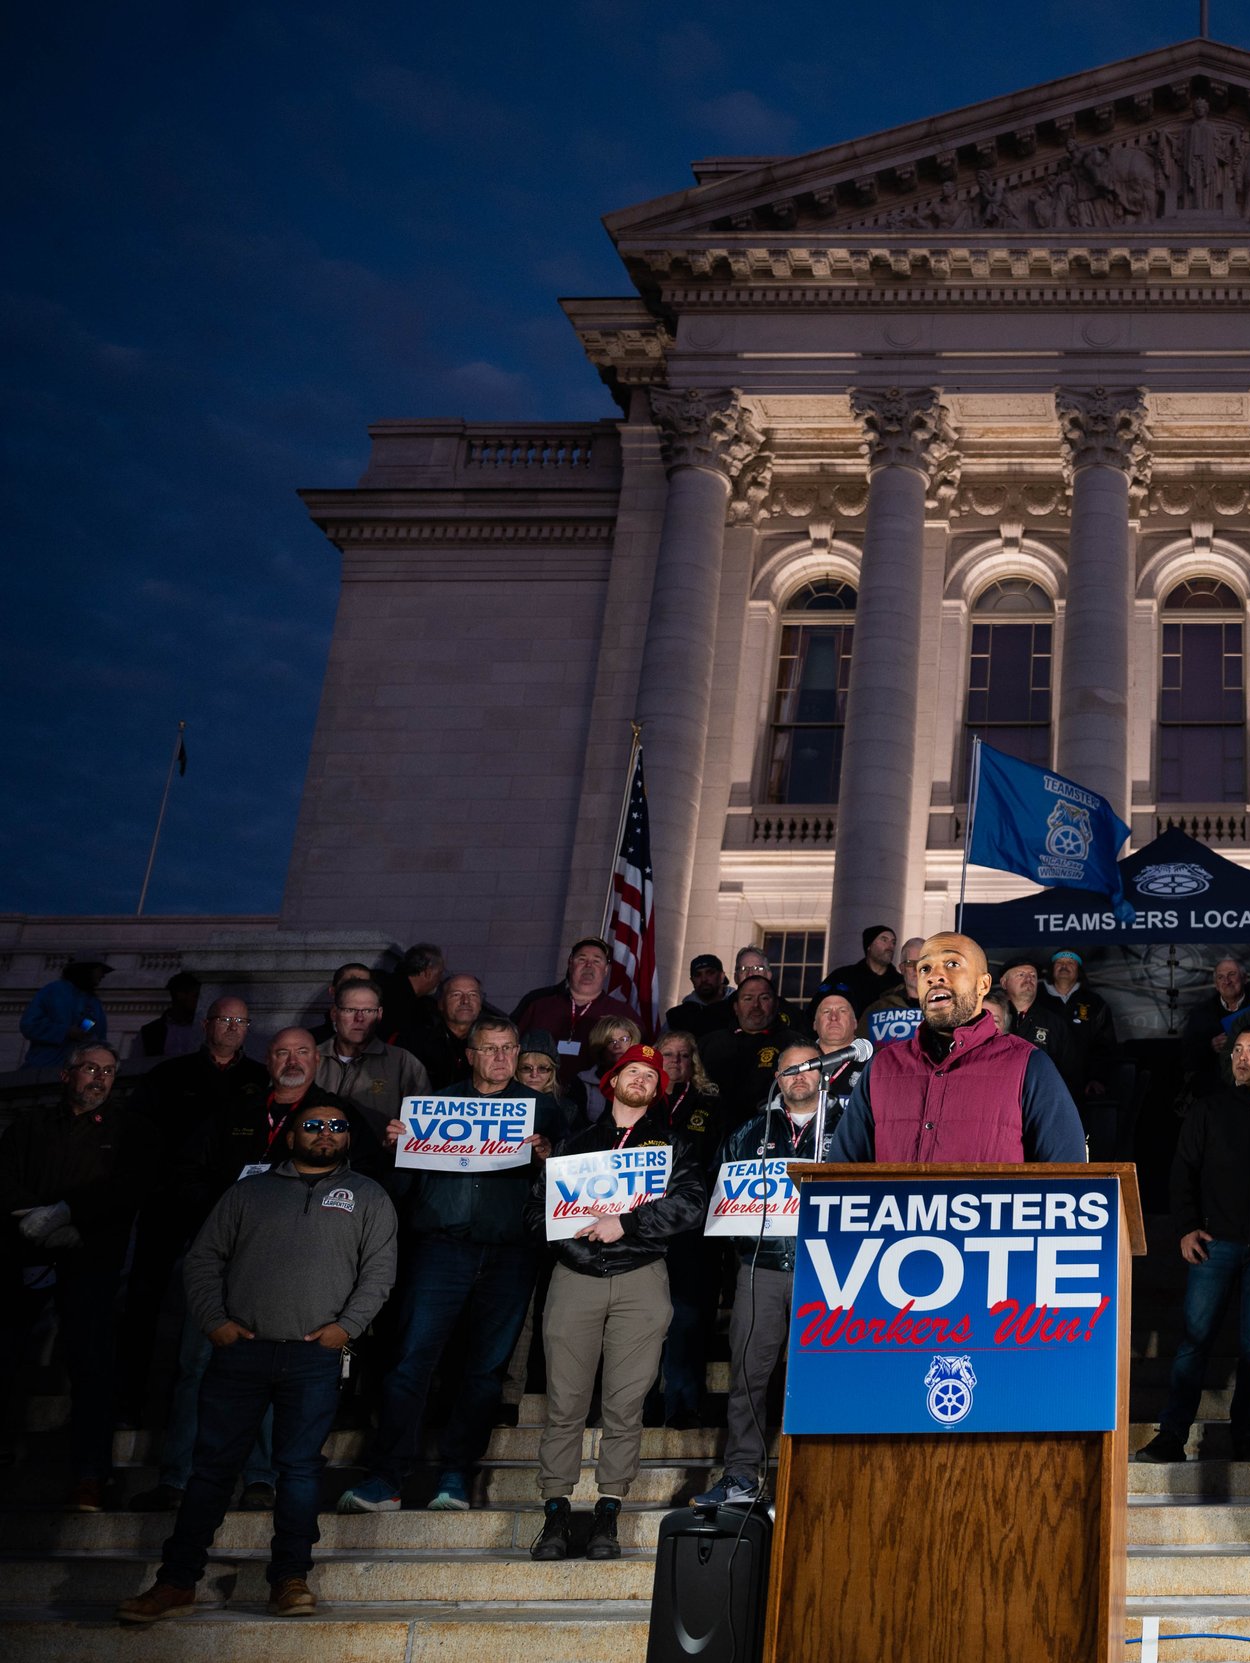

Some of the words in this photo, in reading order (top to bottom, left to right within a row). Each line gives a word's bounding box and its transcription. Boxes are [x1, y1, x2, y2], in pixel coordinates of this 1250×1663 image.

[410, 1100, 527, 1117] TEAMSTERS
[408, 1118, 525, 1142] VOTE
[404, 1137, 476, 1153] Workers
[479, 1138, 525, 1155] Win!
[555, 1169, 667, 1203] VOTE
[714, 1196, 780, 1215] Workers
[809, 1192, 1109, 1232] TEAMSTERS
[804, 1235, 1102, 1311] VOTE
[796, 1299, 974, 1347] Workers
[989, 1296, 1110, 1344] Win!
